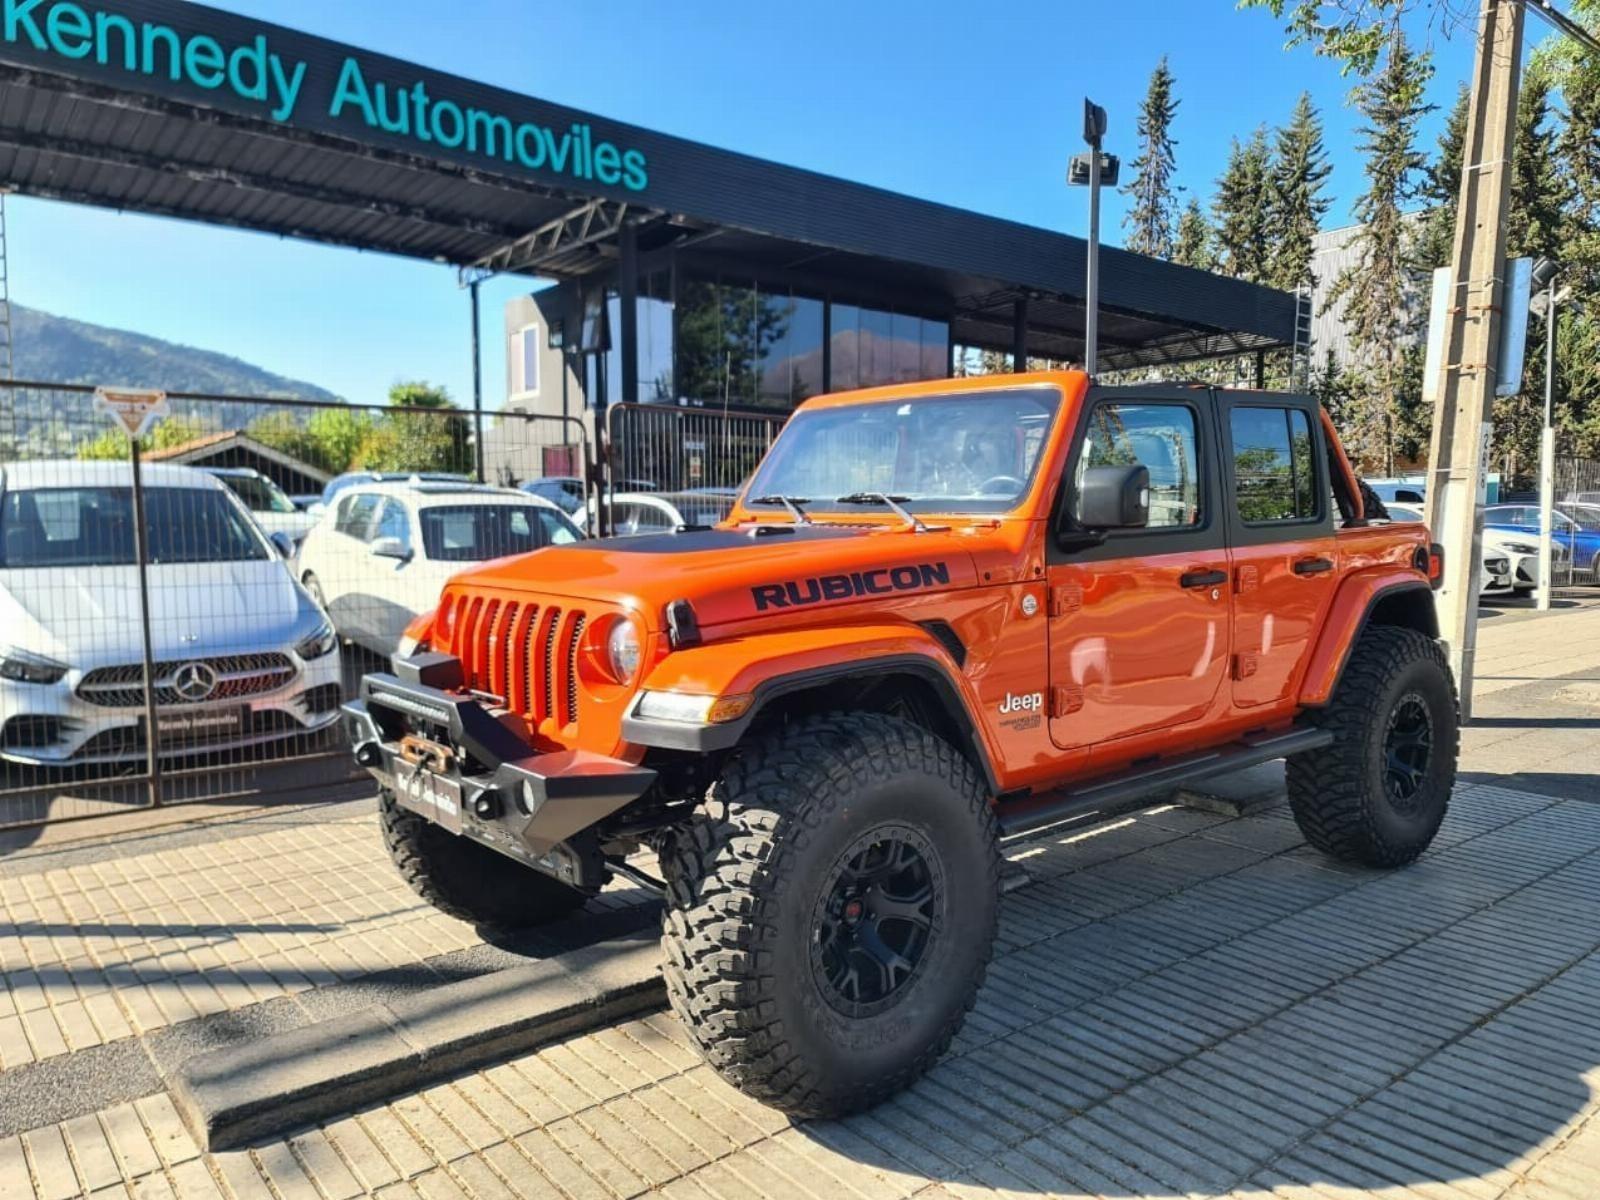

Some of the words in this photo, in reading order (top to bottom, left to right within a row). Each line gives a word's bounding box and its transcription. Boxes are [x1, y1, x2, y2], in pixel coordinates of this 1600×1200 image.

[330, 57, 648, 191] Automoviles
[751, 561, 950, 611] RUBICON
[999, 692, 1042, 713] Jeep
